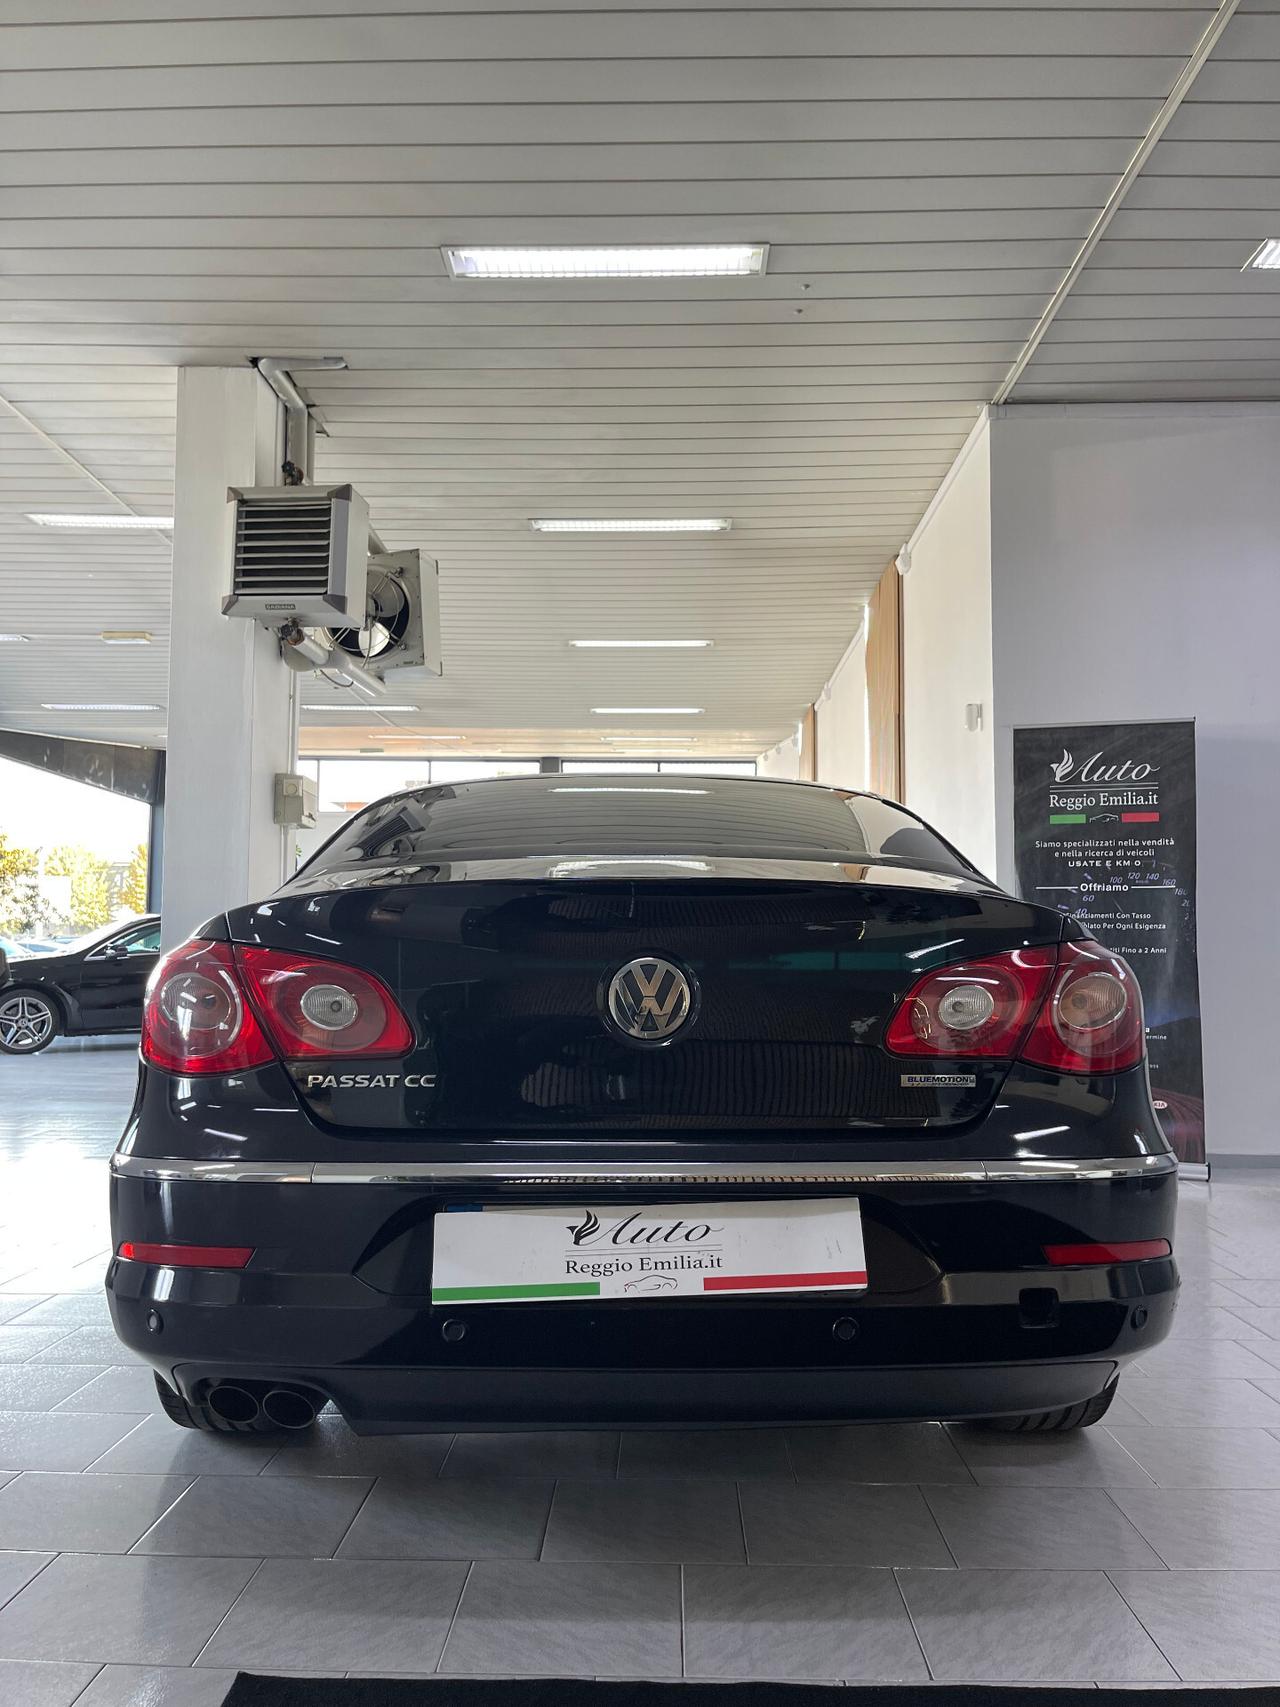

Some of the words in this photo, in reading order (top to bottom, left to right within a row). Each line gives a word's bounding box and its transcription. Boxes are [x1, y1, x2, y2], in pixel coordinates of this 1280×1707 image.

[1068, 751, 1160, 783] Auto
[1049, 794, 1096, 811] Reggio
[1099, 791, 1159, 807] Emilia.it
[1035, 840, 1061, 849] Siamo
[1063, 839, 1116, 849] specializzati
[1118, 838, 1140, 847] nella
[1141, 837, 1175, 846] vendità
[1061, 849, 1083, 858] nella
[1084, 849, 1114, 857] ricerca
[1115, 848, 1125, 857] di
[1126, 848, 1155, 857] veicoli
[1115, 859, 1131, 867] KM
[1109, 876, 1123, 884] 100
[1079, 883, 1129, 892] Offriamo
[1116, 922, 1133, 930] Ogni
[1135, 922, 1166, 930] Esigenza
[307, 1074, 401, 1088] PASSAT
[403, 1074, 437, 1088] CC
[589, 1211, 725, 1247] Auto
[565, 1258, 634, 1278] Reggio
[638, 1254, 724, 1273] Emilia.it
